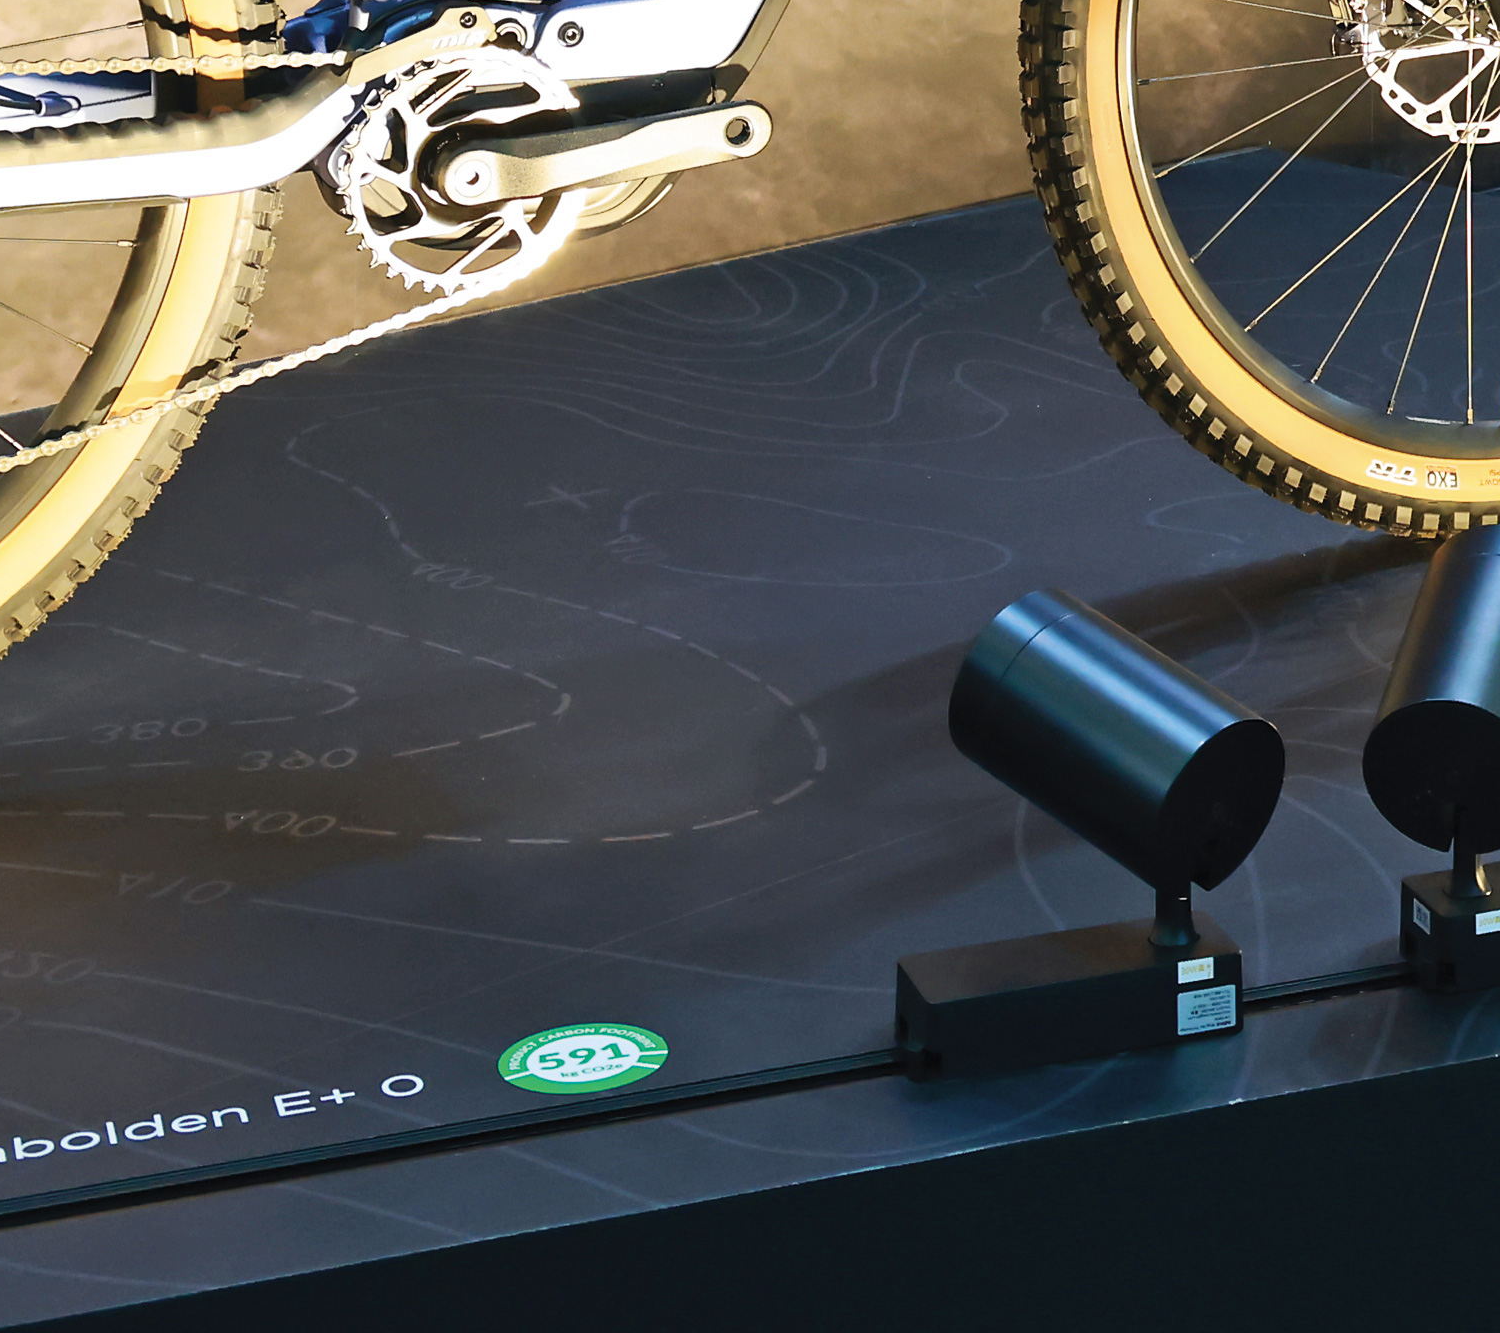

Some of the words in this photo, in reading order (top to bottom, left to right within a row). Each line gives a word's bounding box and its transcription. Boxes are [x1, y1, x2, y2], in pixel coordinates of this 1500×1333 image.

[1426, 470, 1459, 489] EXO
[508, 1041, 538, 1071] PRODUCT
[539, 1027, 596, 1043] CARBON
[539, 1043, 631, 1071] 591
[561, 1071, 580, 1079] kg
[582, 1063, 624, 1075] CO2e
[273, 1087, 357, 1119] E+
